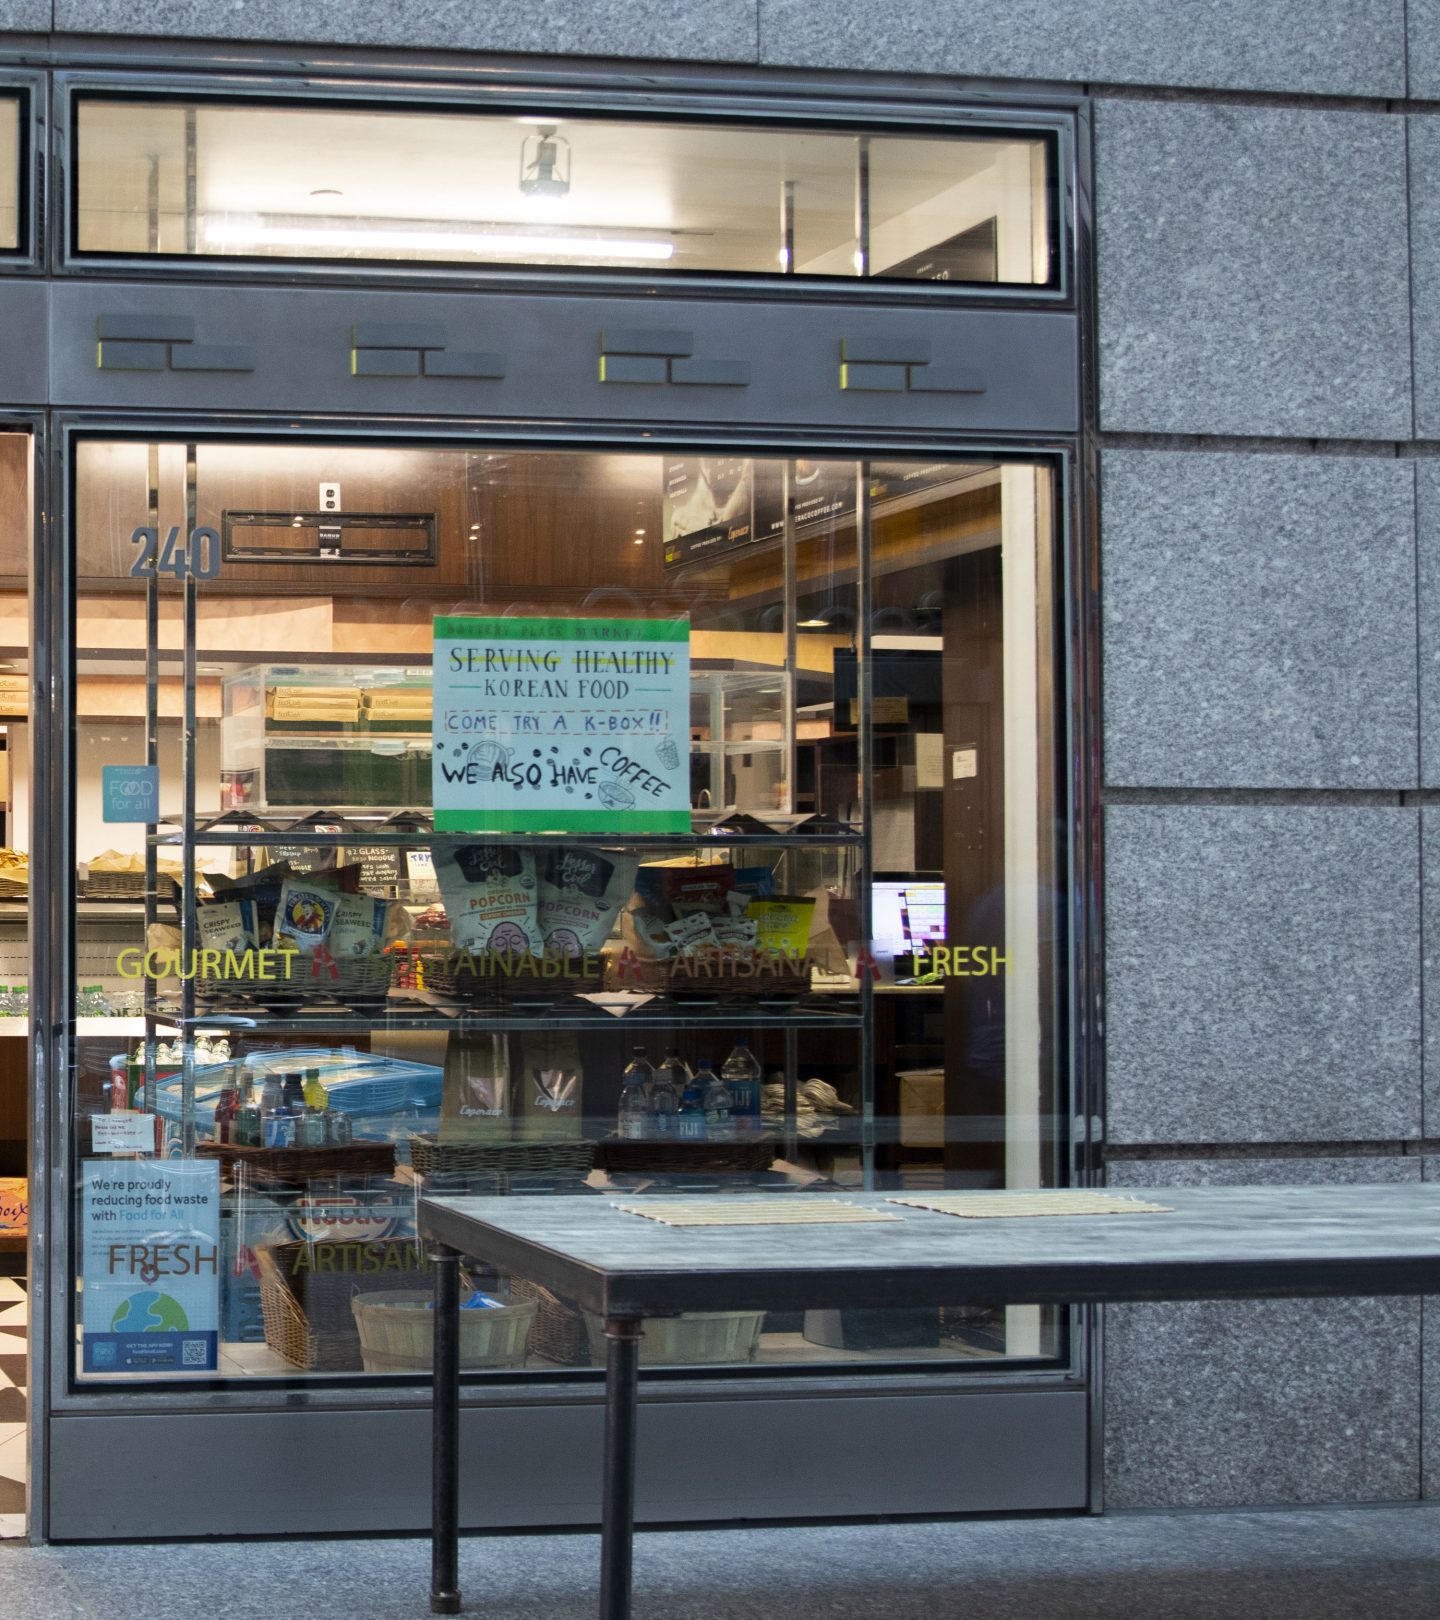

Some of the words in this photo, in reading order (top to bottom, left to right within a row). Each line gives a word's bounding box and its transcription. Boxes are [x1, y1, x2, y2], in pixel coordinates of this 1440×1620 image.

[130, 526, 220, 580] 240
[449, 647, 558, 672] SERVING
[575, 650, 674, 675] HEALTHY
[484, 678, 569, 698] KOREAN
[578, 679, 629, 699] FOOD
[448, 714, 497, 730] COME
[513, 715, 541, 730] TRY
[553, 714, 567, 730] A
[441, 762, 479, 784] WE
[491, 762, 542, 785] ALSO
[551, 763, 600, 785] HAVE
[599, 747, 671, 798] COFFEE
[112, 797, 131, 810] for
[135, 798, 150, 810] all
[469, 892, 530, 910] POPCORN
[538, 901, 600, 921] POPCORN
[203, 918, 230, 929] CRISPY
[205, 922, 241, 933] SEAWEED
[335, 918, 372, 928] SEAWEED
[116, 947, 300, 980] GOURMET
[370, 945, 601, 979] SUSTAINABLE
[913, 946, 1013, 976] FRESH
[679, 1121, 699, 1137] FIJI
[92, 1179, 125, 1190] We're
[127, 1179, 171, 1192] proudly
[91, 1195, 143, 1208] reducing
[145, 1193, 171, 1205] food
[173, 1195, 208, 1204] waste
[91, 1210, 117, 1221] with
[120, 1210, 148, 1220] Food
[150, 1209, 167, 1220] for
[169, 1209, 184, 1219] All
[109, 1244, 218, 1276] FRESH
[292, 1244, 471, 1276] ARTISAN
